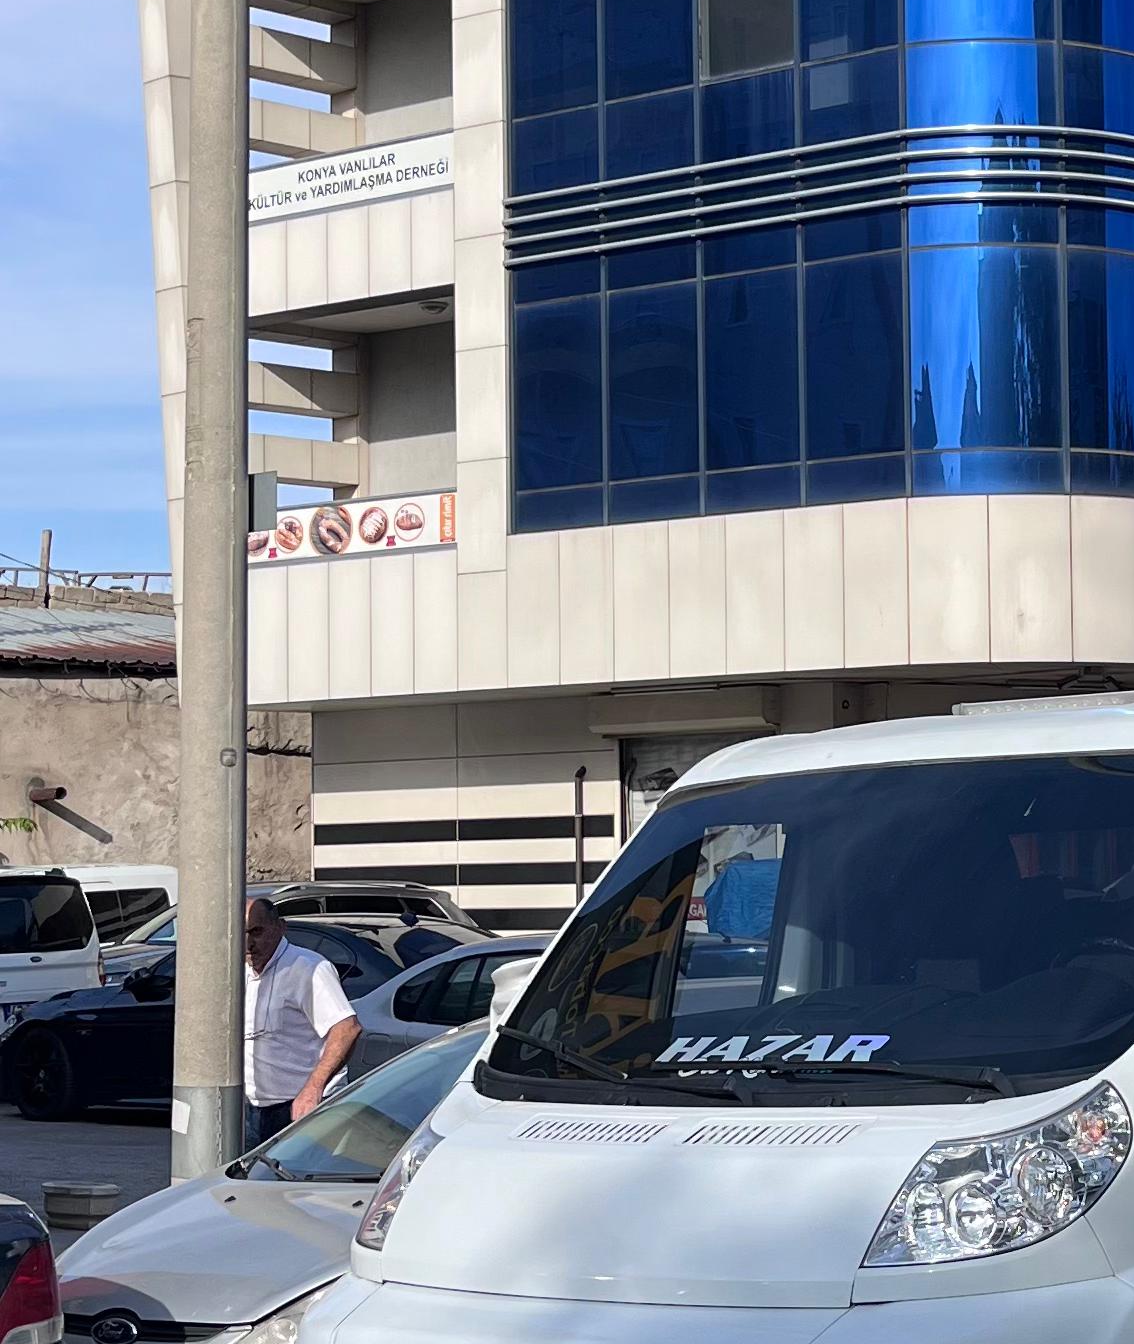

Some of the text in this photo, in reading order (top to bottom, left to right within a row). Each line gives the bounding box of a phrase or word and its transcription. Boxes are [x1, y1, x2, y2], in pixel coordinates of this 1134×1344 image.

[249, 156, 449, 211] KÜLTÜR ve YARDIMLAŞMA DERNEĞİ
[297, 153, 396, 184] KONYA VANLILAR
[654, 1034, 890, 1063] HAZAR
